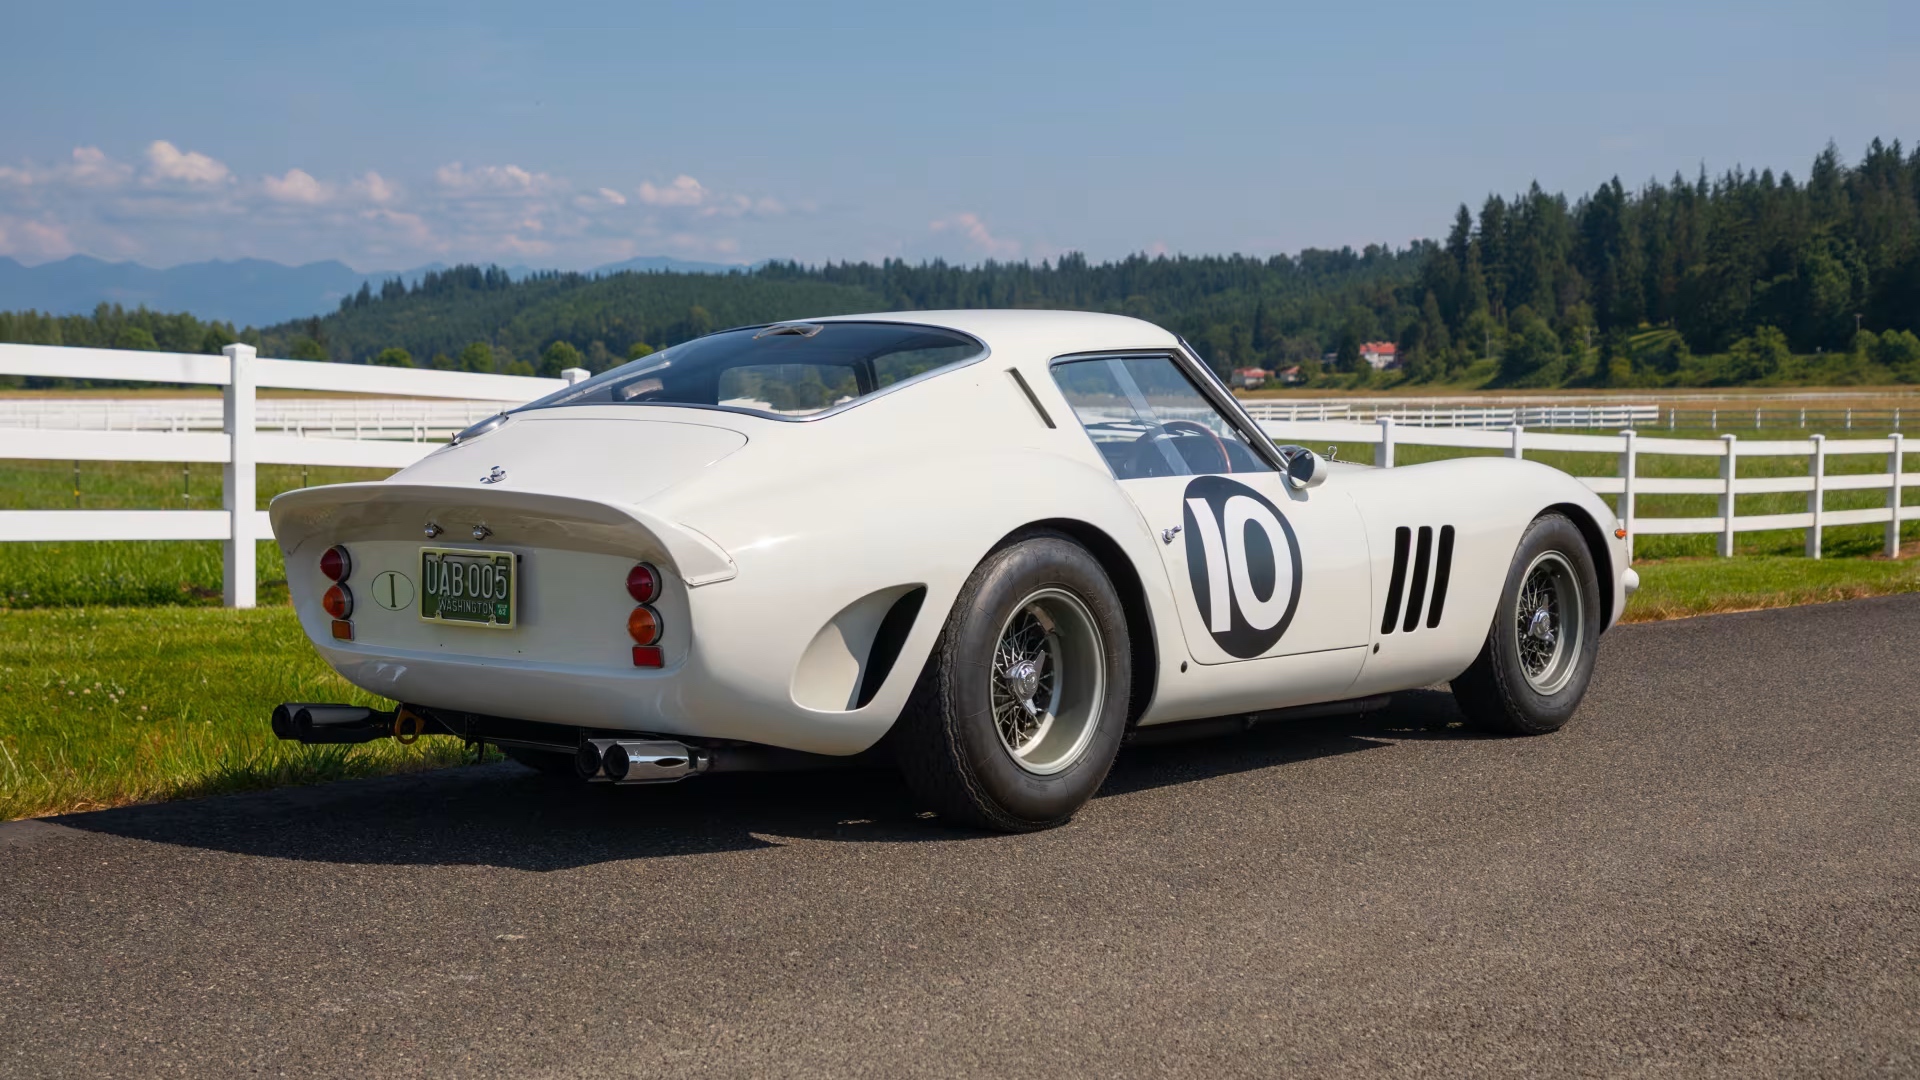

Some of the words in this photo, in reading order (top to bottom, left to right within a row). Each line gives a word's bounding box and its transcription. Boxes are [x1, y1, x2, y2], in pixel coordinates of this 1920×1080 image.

[427, 561, 463, 597] UAB
[468, 564, 507, 599] 005
[1185, 495, 1293, 633] 10
[440, 599, 494, 614] WASHINGTON
